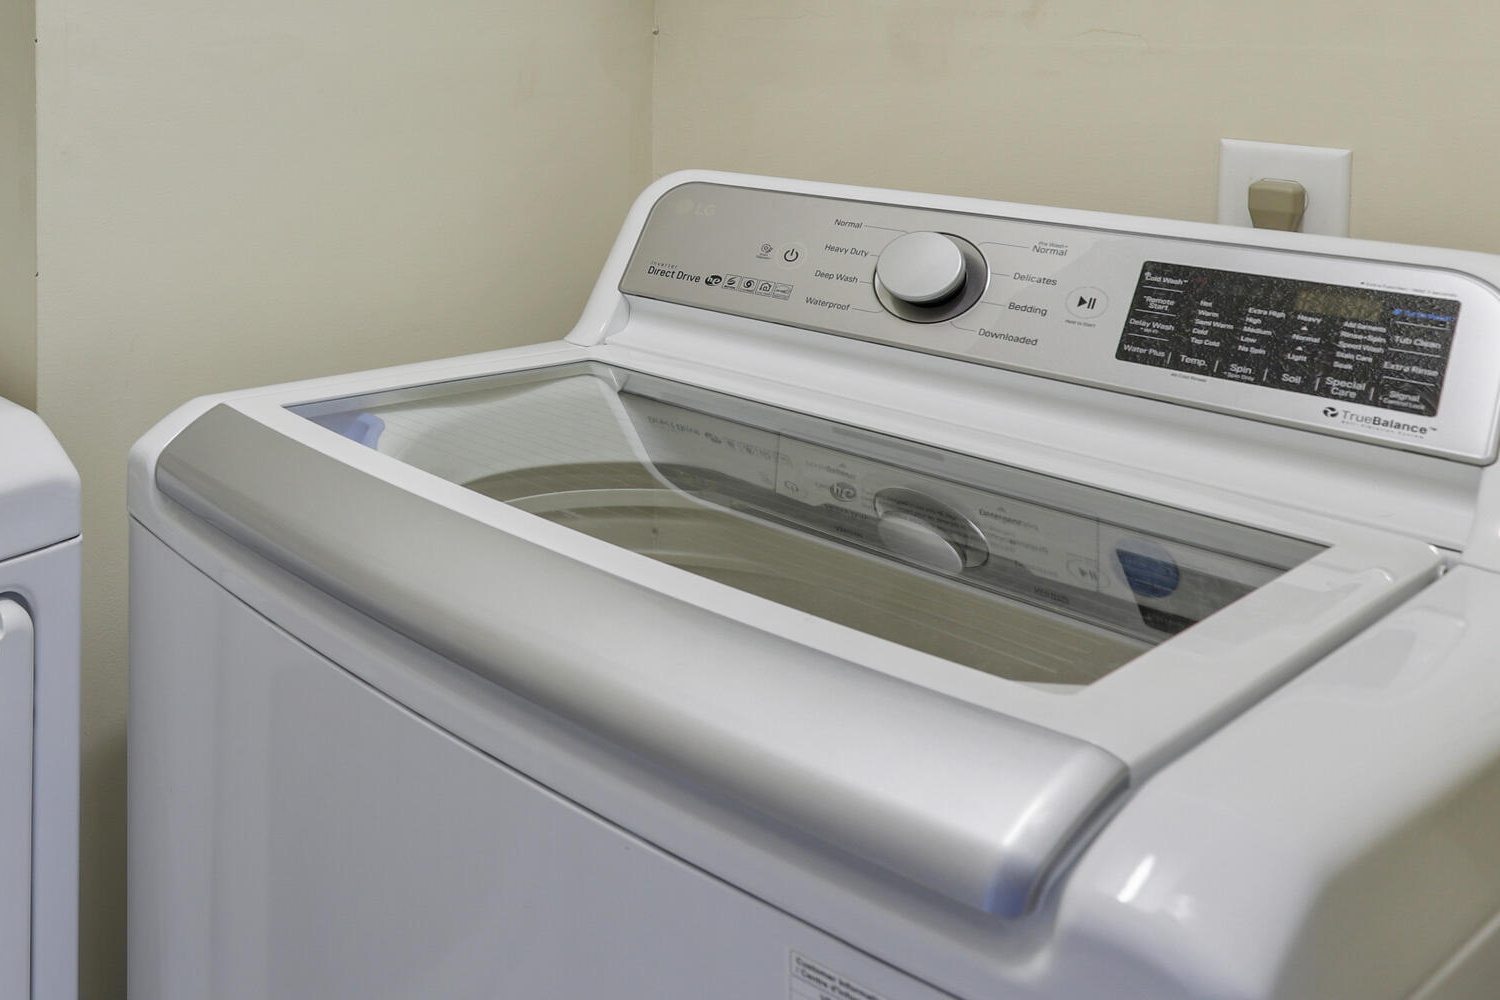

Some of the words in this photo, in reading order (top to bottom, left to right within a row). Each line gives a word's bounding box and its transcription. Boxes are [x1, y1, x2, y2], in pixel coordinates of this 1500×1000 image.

[834, 219, 863, 229] Normal
[825, 244, 848, 255] Heavy
[850, 247, 869, 257] Duty
[1032, 245, 1067, 256] Normal
[647, 266, 675, 279] Direct
[676, 270, 701, 283] Drive
[814, 270, 835, 280] Deep
[836, 273, 858, 284] Wash
[1013, 272, 1058, 286] Delicates
[1145, 275, 1161, 283] Cold
[805, 296, 850, 311] Waterproof
[1008, 301, 1048, 317] Bedding
[1148, 302, 1169, 311] Start
[1198, 309, 1219, 318] Warm
[1248, 307, 1268, 316] Extra
[1268, 309, 1286, 319] High
[1297, 314, 1322, 324] Heavy
[1129, 318, 1151, 328] Delay
[1151, 322, 1175, 331] Wash
[1212, 321, 1234, 330] Warm
[1245, 316, 1262, 325] High
[978, 328, 1038, 346] Downloaded
[1192, 327, 1208, 336] Cold
[1242, 326, 1272, 336] Medium
[1190, 336, 1203, 345] Tap
[1203, 338, 1221, 348] Cold
[1240, 335, 1257, 344] Low
[1291, 333, 1321, 344] Normal
[1394, 335, 1412, 345] Tub
[1413, 337, 1441, 349] Clean
[1123, 344, 1147, 354] Water
[1148, 347, 1165, 357] Plus
[1238, 344, 1249, 352] No
[1249, 346, 1266, 355] Spin
[1362, 344, 1385, 354] Wash
[1180, 354, 1207, 367] Temp.
[1287, 352, 1307, 362] Light
[1355, 353, 1373, 363] Care
[1230, 363, 1252, 375] Spin
[1383, 360, 1410, 373] Extra
[1411, 365, 1439, 377] Rinse
[1281, 373, 1302, 384] Soil
[1325, 376, 1366, 391] Special
[1331, 386, 1357, 399] Care
[1389, 390, 1421, 403] Signal
